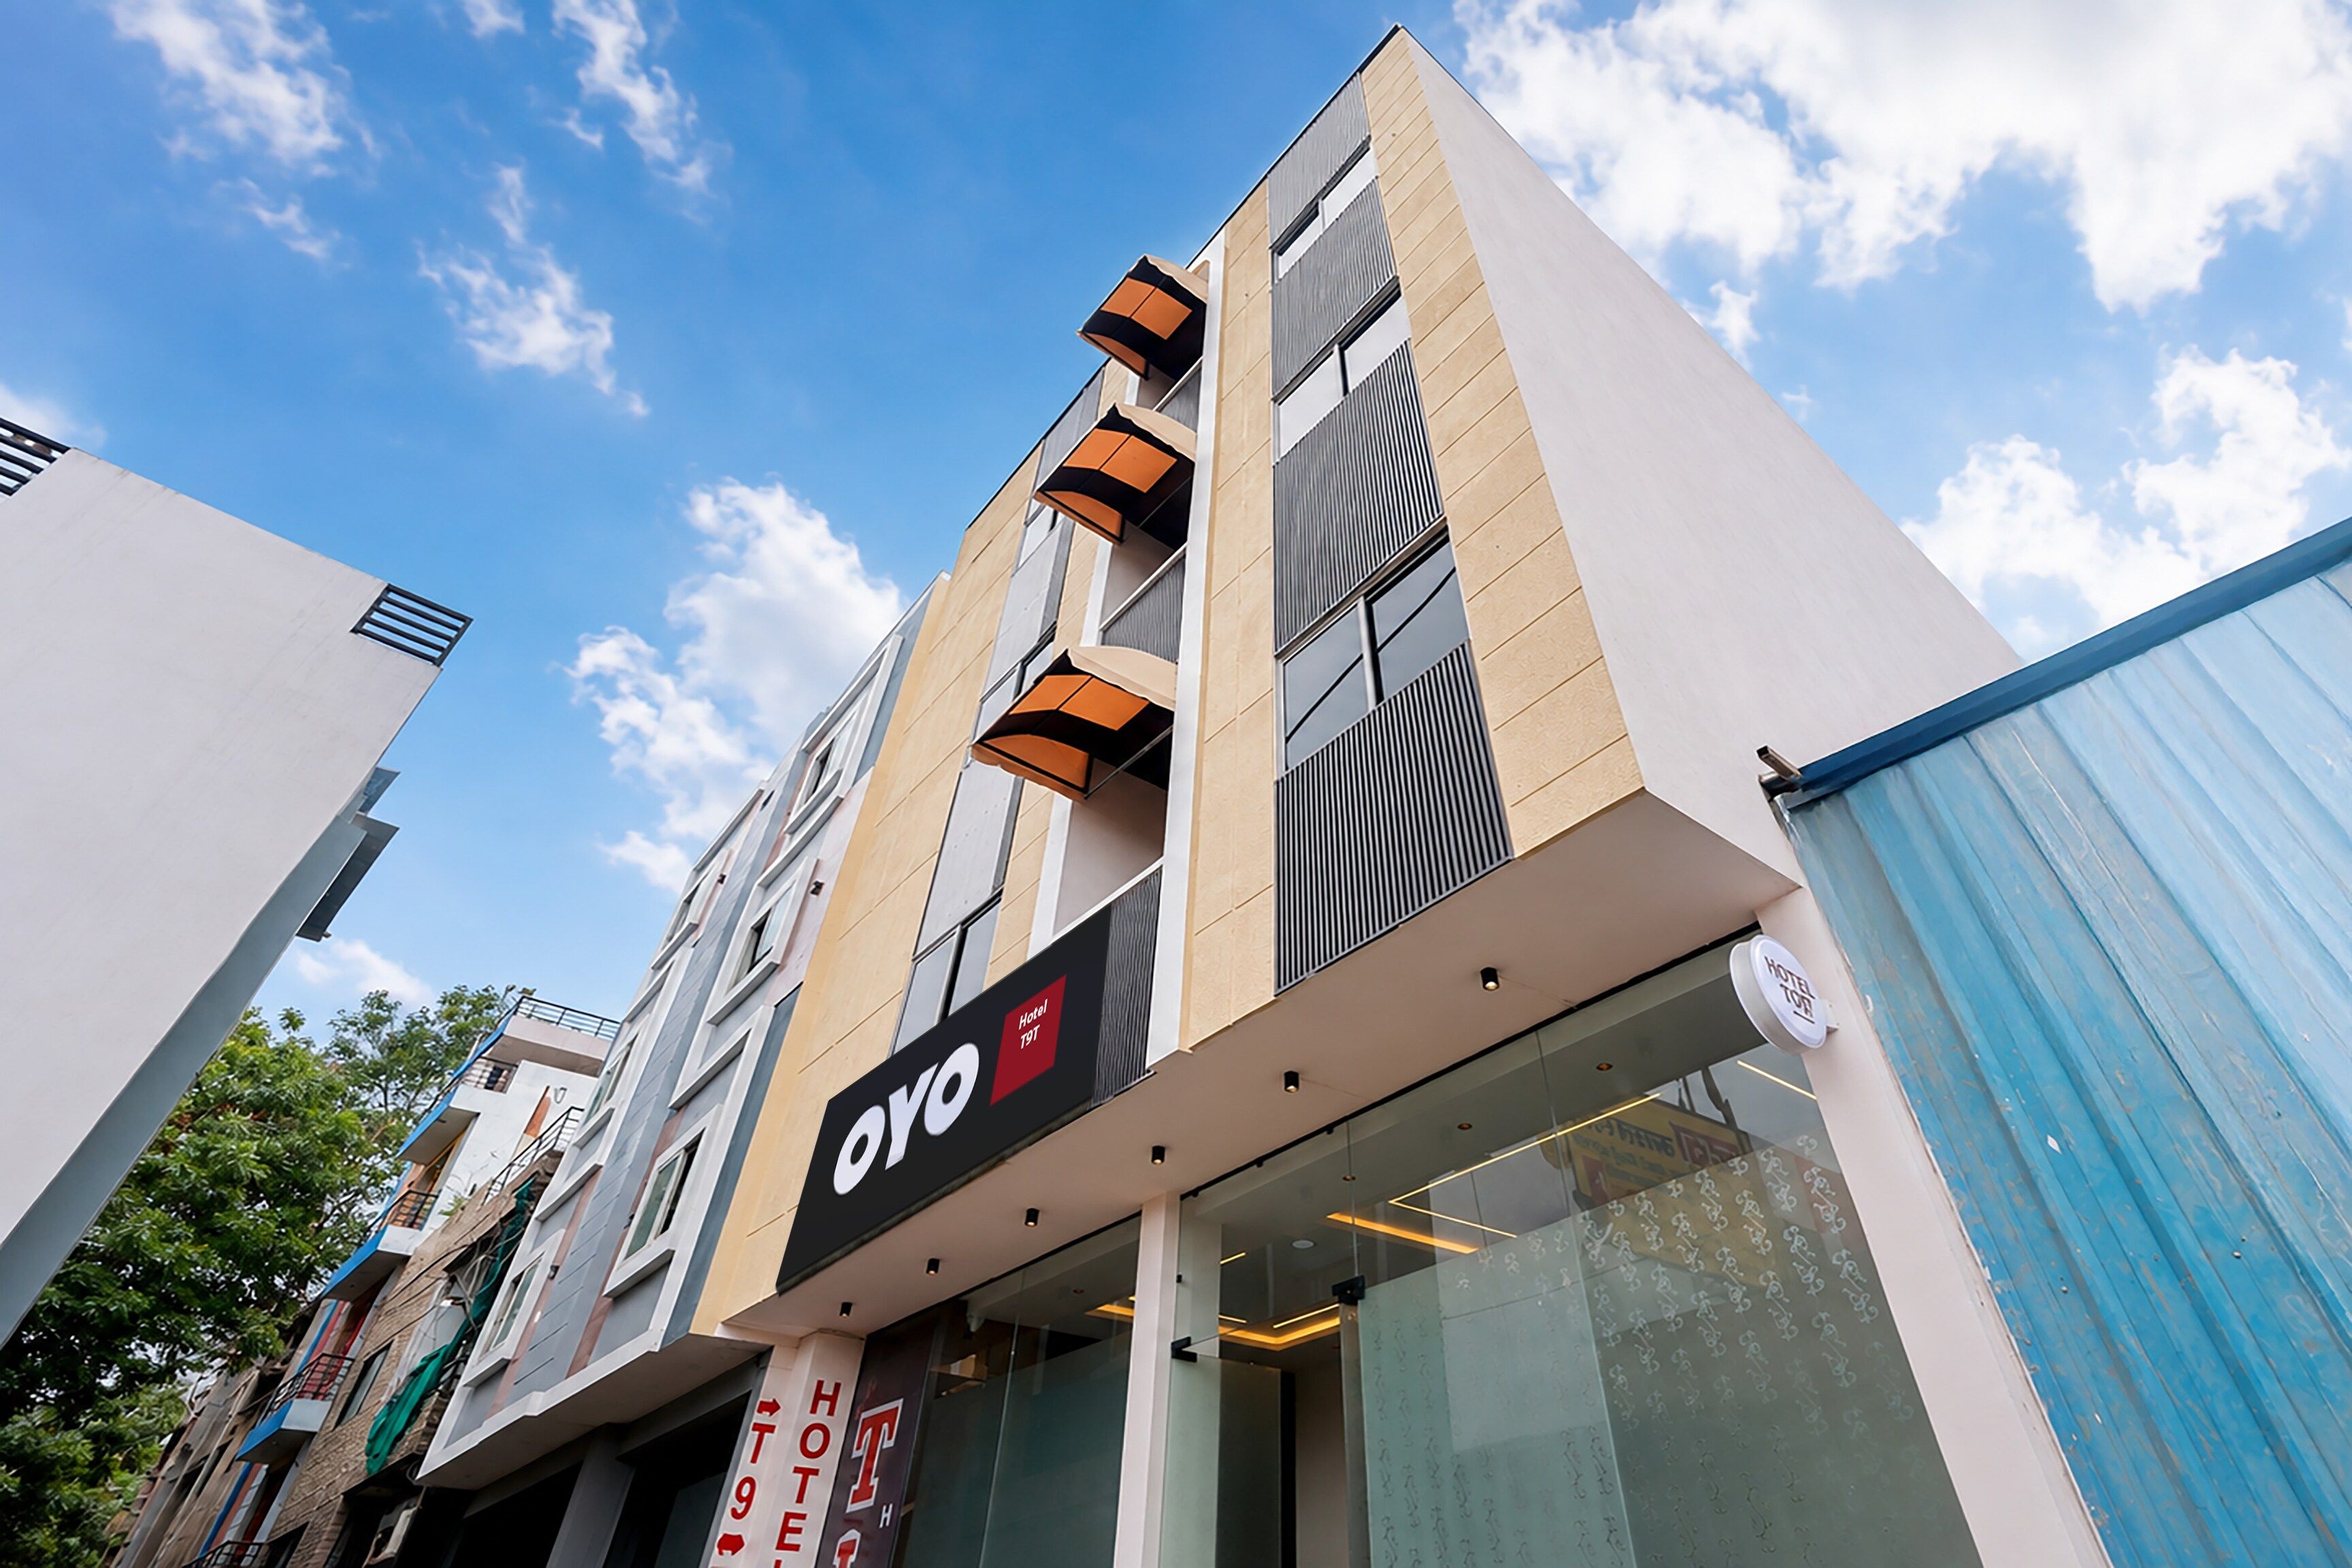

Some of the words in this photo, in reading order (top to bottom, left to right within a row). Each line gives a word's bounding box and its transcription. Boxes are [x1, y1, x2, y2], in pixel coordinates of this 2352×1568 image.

[1764, 956, 1816, 999] HOTEL
[1018, 998, 1048, 1030] Hotel
[1021, 1024, 1040, 1049] T9T
[833, 1043, 979, 1195] OYO
[774, 1379, 841, 1568] HOTE
